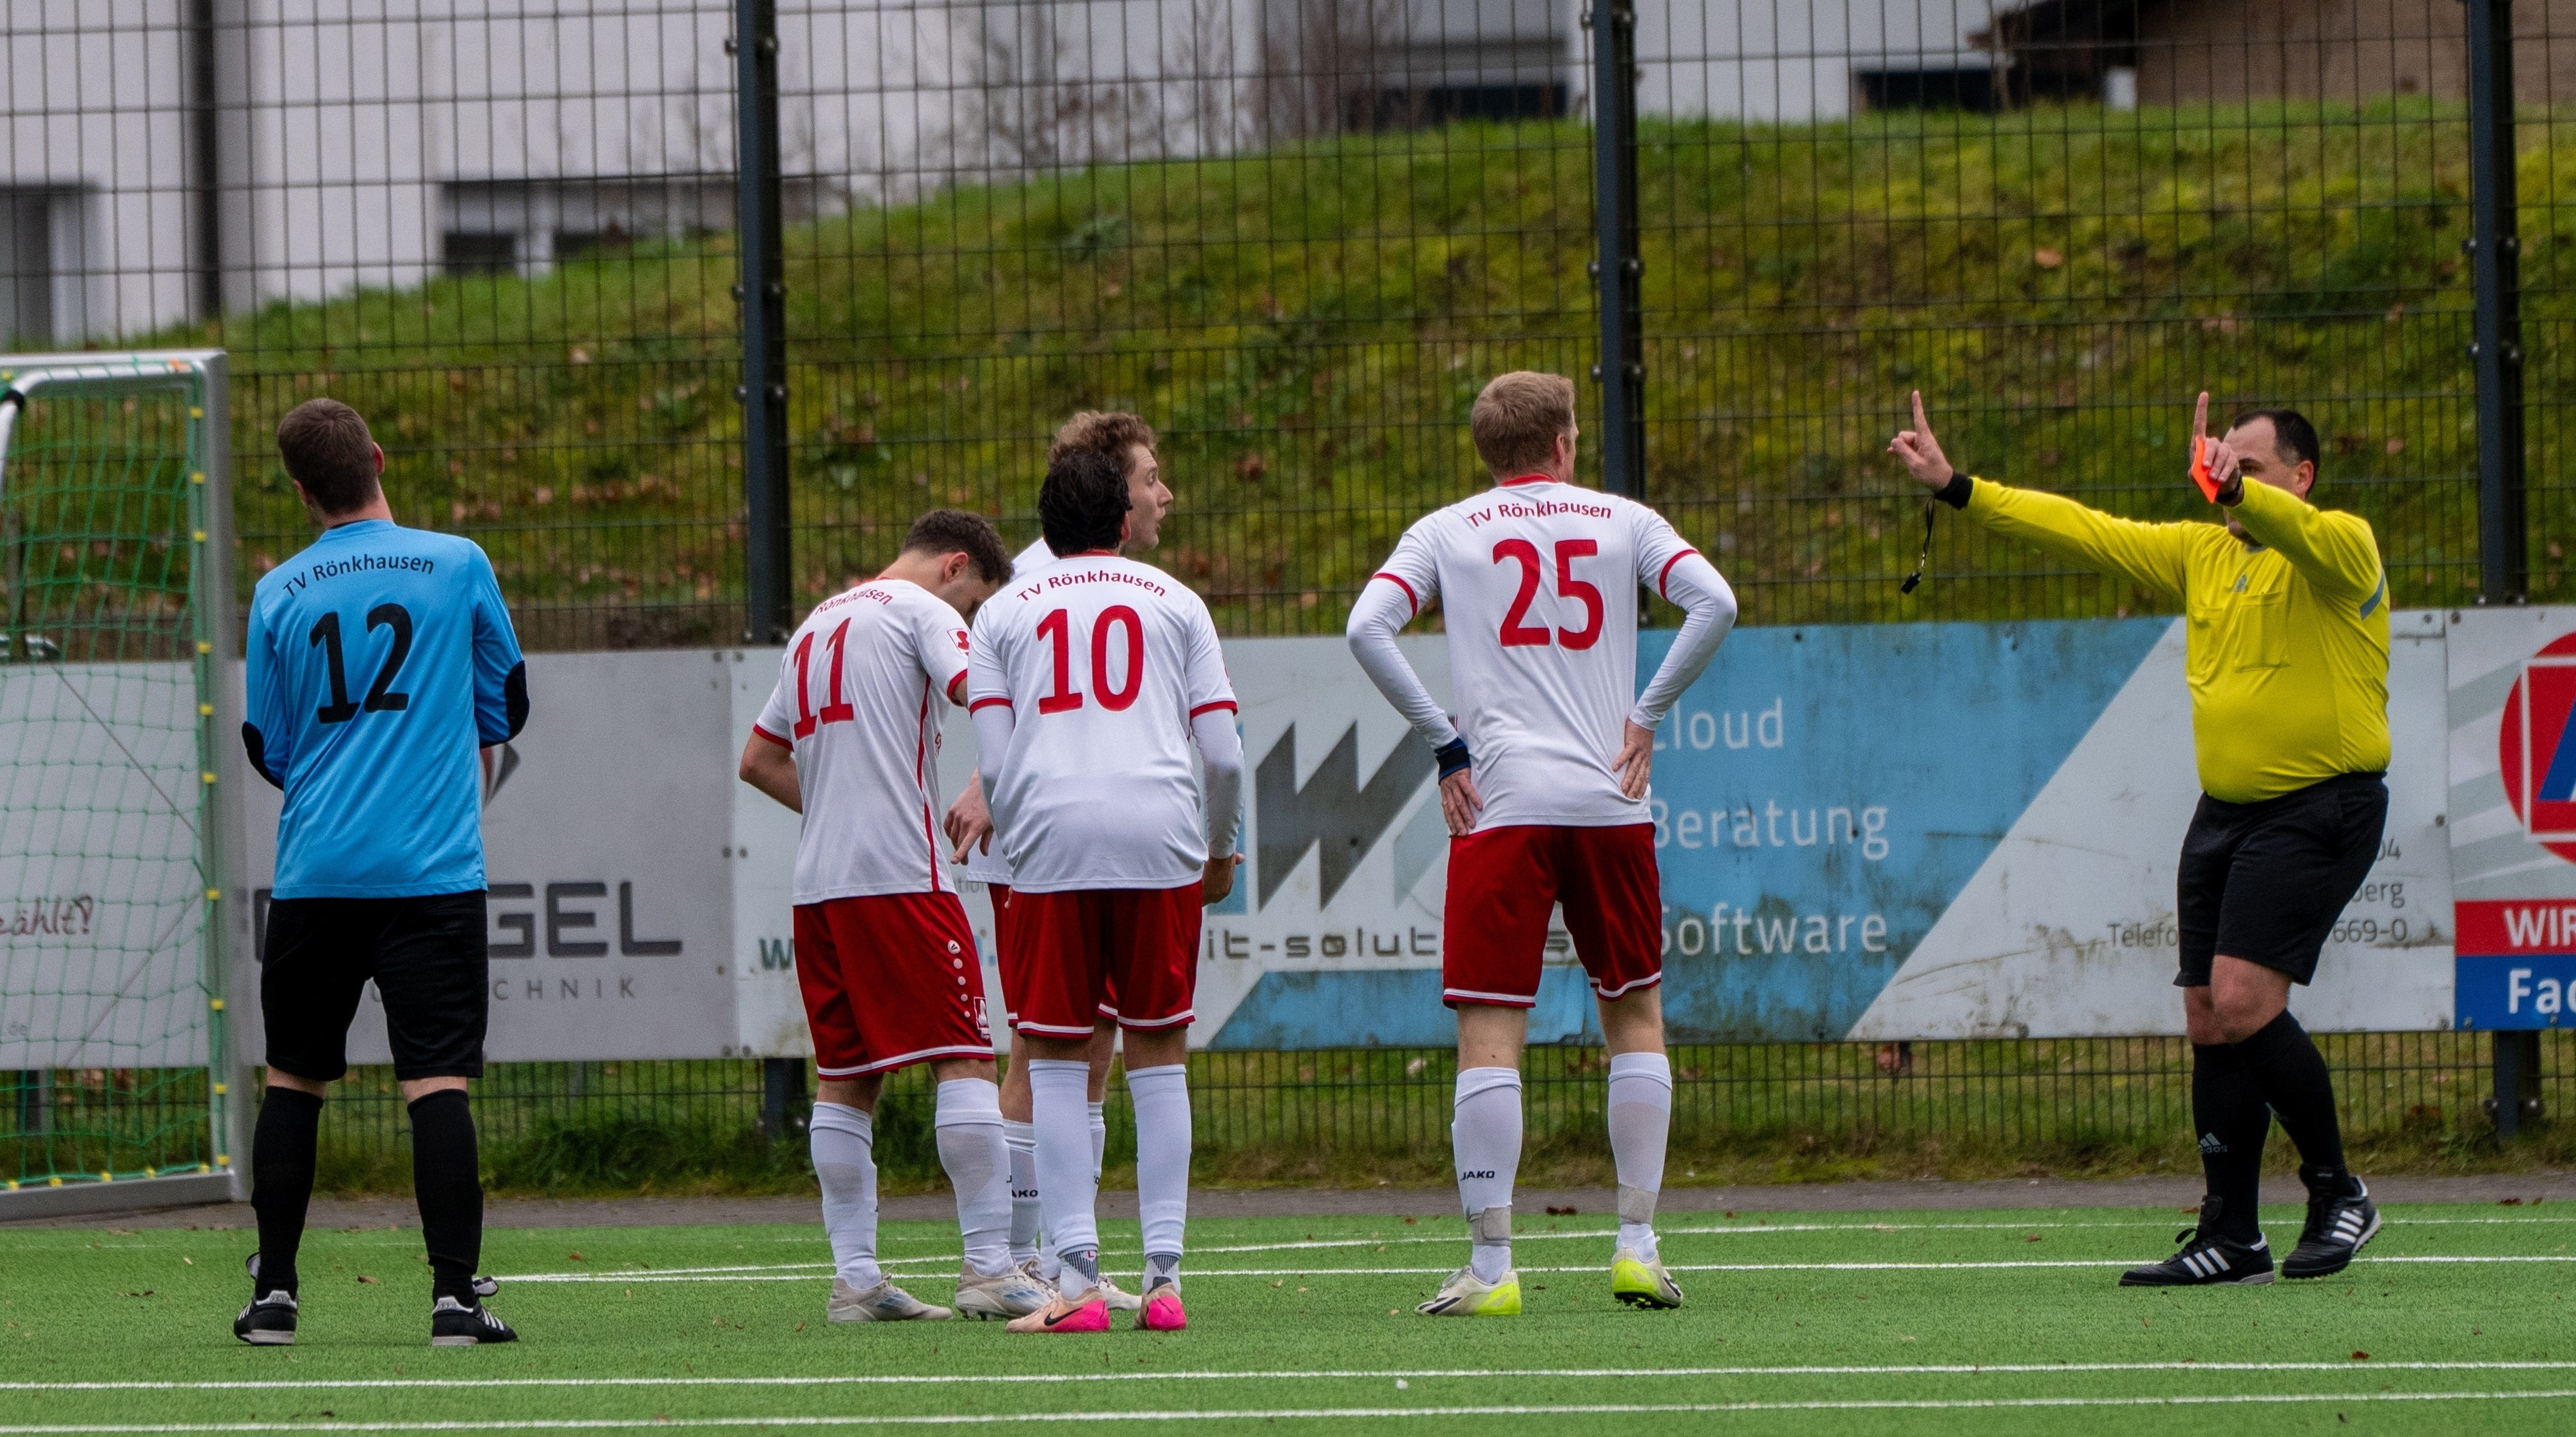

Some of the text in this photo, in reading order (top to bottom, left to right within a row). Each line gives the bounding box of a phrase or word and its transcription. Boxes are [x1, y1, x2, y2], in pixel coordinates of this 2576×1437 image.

[1467, 500, 1612, 528] TV Rönkhausen
[283, 553, 435, 597] TV Rönkhausen
[1017, 570, 1166, 602] TV Rönkhausen
[1493, 538, 1604, 651] 25
[309, 602, 413, 724] 12
[793, 617, 854, 741] 11
[1037, 605, 1144, 715] 10
[1653, 696, 1784, 751] loud
[2107, 922, 2179, 948] Telefo
[1460, 1170, 1495, 1181] JAKO
